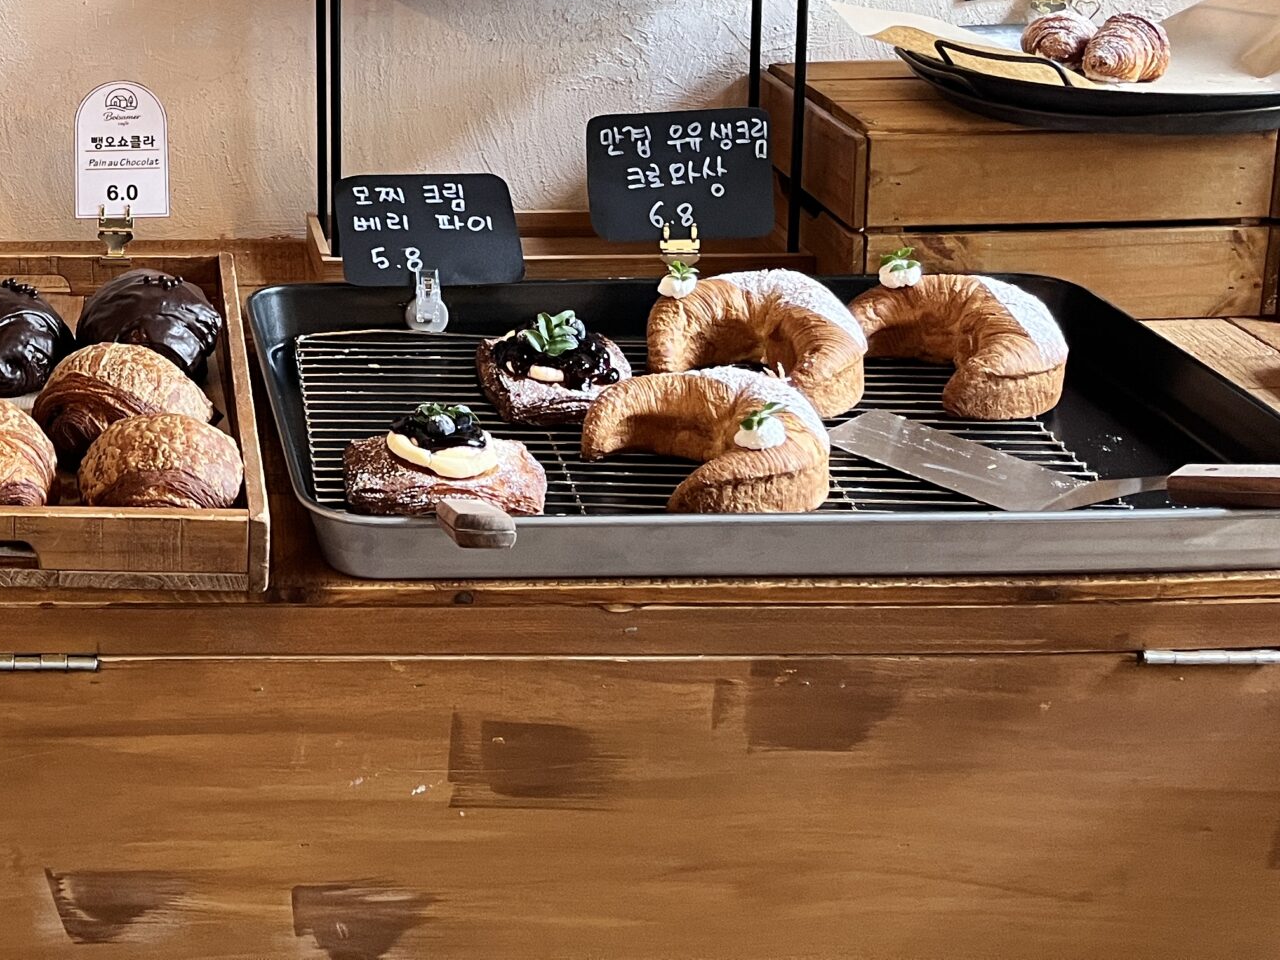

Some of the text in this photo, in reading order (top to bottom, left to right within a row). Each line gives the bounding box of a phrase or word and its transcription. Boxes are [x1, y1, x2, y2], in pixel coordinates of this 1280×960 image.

[600, 118, 768, 159] 만겹 우유 생크림
[89, 159, 106, 167] Pain
[120, 158, 160, 167] Chocolat
[627, 156, 727, 197] 크로와상
[107, 185, 138, 201] 6.0
[352, 183, 465, 212] 모찌 크림
[353, 212, 493, 231] 베리 파이
[649, 201, 693, 228] 6.8
[371, 247, 423, 272] 5.8
